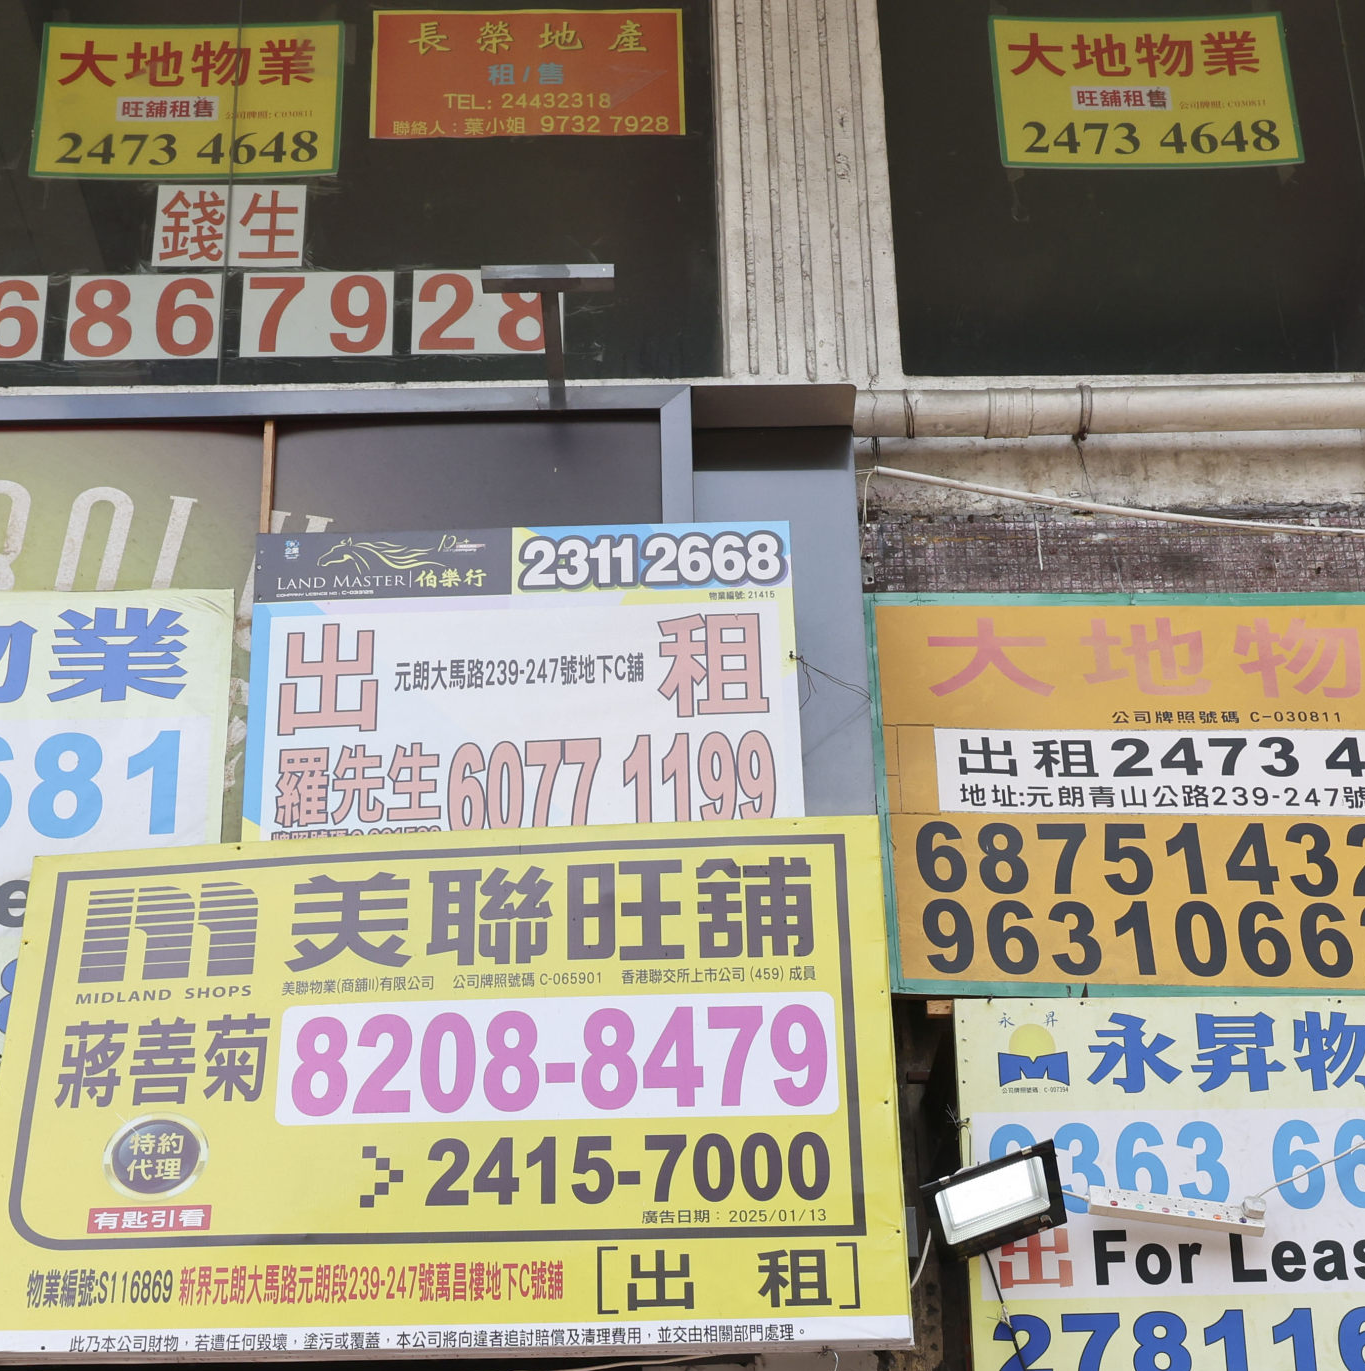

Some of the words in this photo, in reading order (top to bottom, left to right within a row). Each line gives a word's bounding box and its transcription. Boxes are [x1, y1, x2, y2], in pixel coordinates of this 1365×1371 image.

[408, 20, 648, 54] 長榮地產
[1008, 31, 1260, 78] 大地物業
[57, 38, 317, 88] 大地物業
[443, 93, 492, 110] TEL:
[501, 93, 612, 109] 24432318
[540, 115, 601, 133] 9732
[609, 115, 670, 133] 7928
[1022, 121, 1142, 155] 2473
[1160, 119, 1280, 153] 4648
[57, 131, 178, 167] 2473
[197, 129, 320, 166] 4648
[277, 577, 326, 590] LAND
[333, 574, 406, 587] MASTER
[415, 568, 487, 588] 伯樂行
[1112, 710, 1239, 724] 公司牌照號碼
[1250, 709, 1342, 723] C-030811
[1111, 737, 1300, 778] 2473
[448, 737, 601, 831] 6077
[623, 731, 776, 822] 1199
[285, 856, 815, 972] 美聯旺舖
[75, 988, 176, 1005] MIDLAND
[185, 984, 253, 999] SHOPS
[539, 970, 603, 987] C-065901
[55, 1012, 268, 1109] 蔣善菊
[290, 1004, 828, 1117] 8208-8479
[128, 1131, 185, 1156] 特約
[126, 1156, 182, 1182] 代理
[426, 1131, 831, 1208] 2415-7000
[94, 1210, 206, 1229] 有匙引看
[728, 1207, 827, 1224] 2025/01/13
[1092, 1230, 1201, 1286] For
